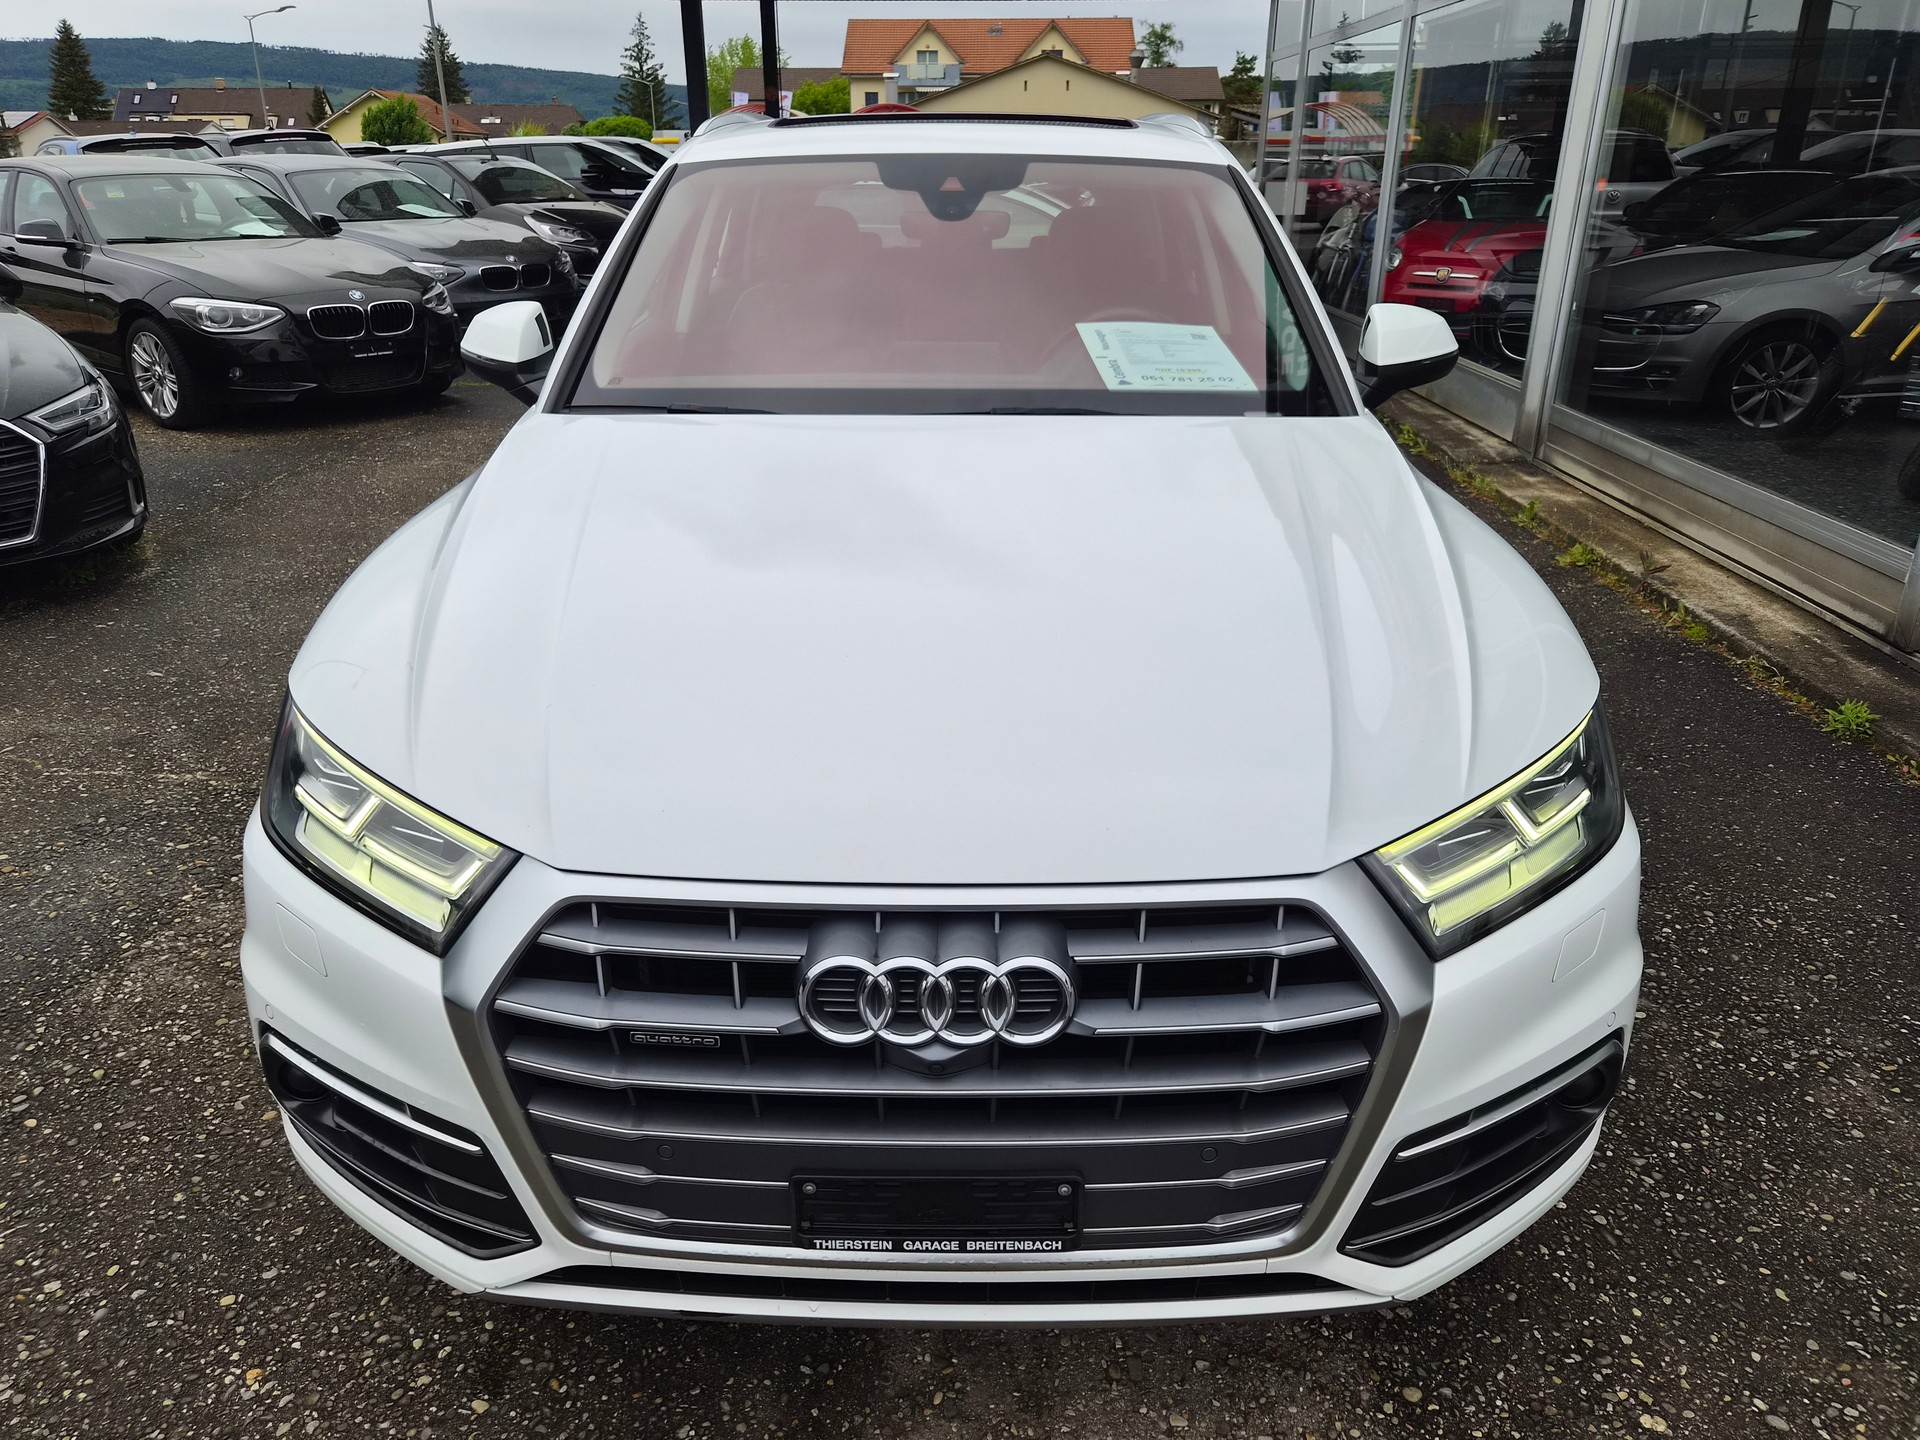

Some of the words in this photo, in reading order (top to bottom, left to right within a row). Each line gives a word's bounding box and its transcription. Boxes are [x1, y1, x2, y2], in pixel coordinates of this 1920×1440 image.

[633, 1034, 716, 1045] quattro
[813, 1239, 893, 1250] THIERSTEIN
[902, 1240, 960, 1251] GARAGE
[966, 1240, 1062, 1251] BREITENBACH
